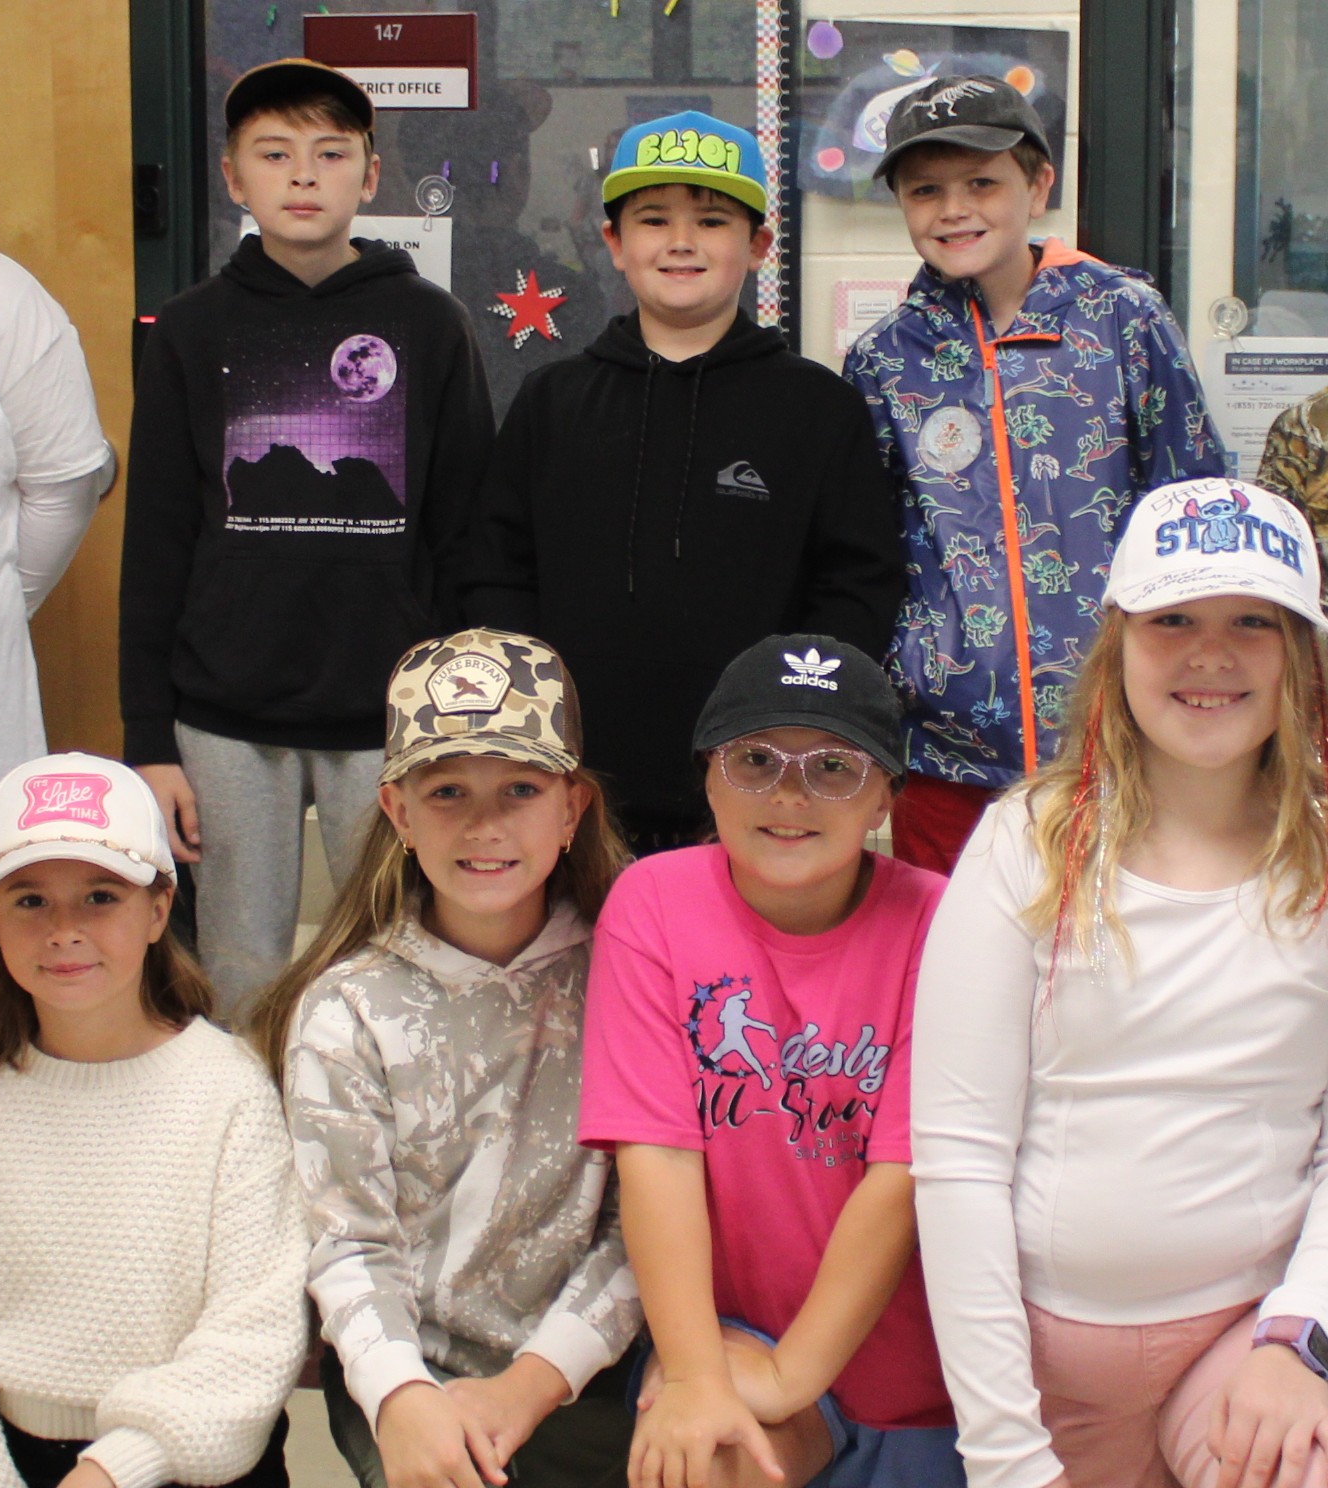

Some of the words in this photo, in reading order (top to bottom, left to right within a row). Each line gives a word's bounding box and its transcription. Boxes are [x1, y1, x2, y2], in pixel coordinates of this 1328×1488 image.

[374, 24, 403, 41] 147
[360, 82, 395, 94] TRICT
[398, 82, 442, 94] OFFICE
[385, 241, 400, 250] OB
[404, 241, 420, 250] ON
[1231, 358, 1241, 366] IN
[1242, 358, 1261, 366] CASE
[1263, 358, 1274, 366] OF
[1276, 358, 1324, 366] WORKPLACE
[1154, 513, 1304, 578] STTCH
[434, 660, 463, 686] LUKE
[464, 659, 504, 683] BRYAN
[780, 672, 839, 691] adidas
[35, 780, 93, 815] Lake
[69, 807, 99, 820] TIME
